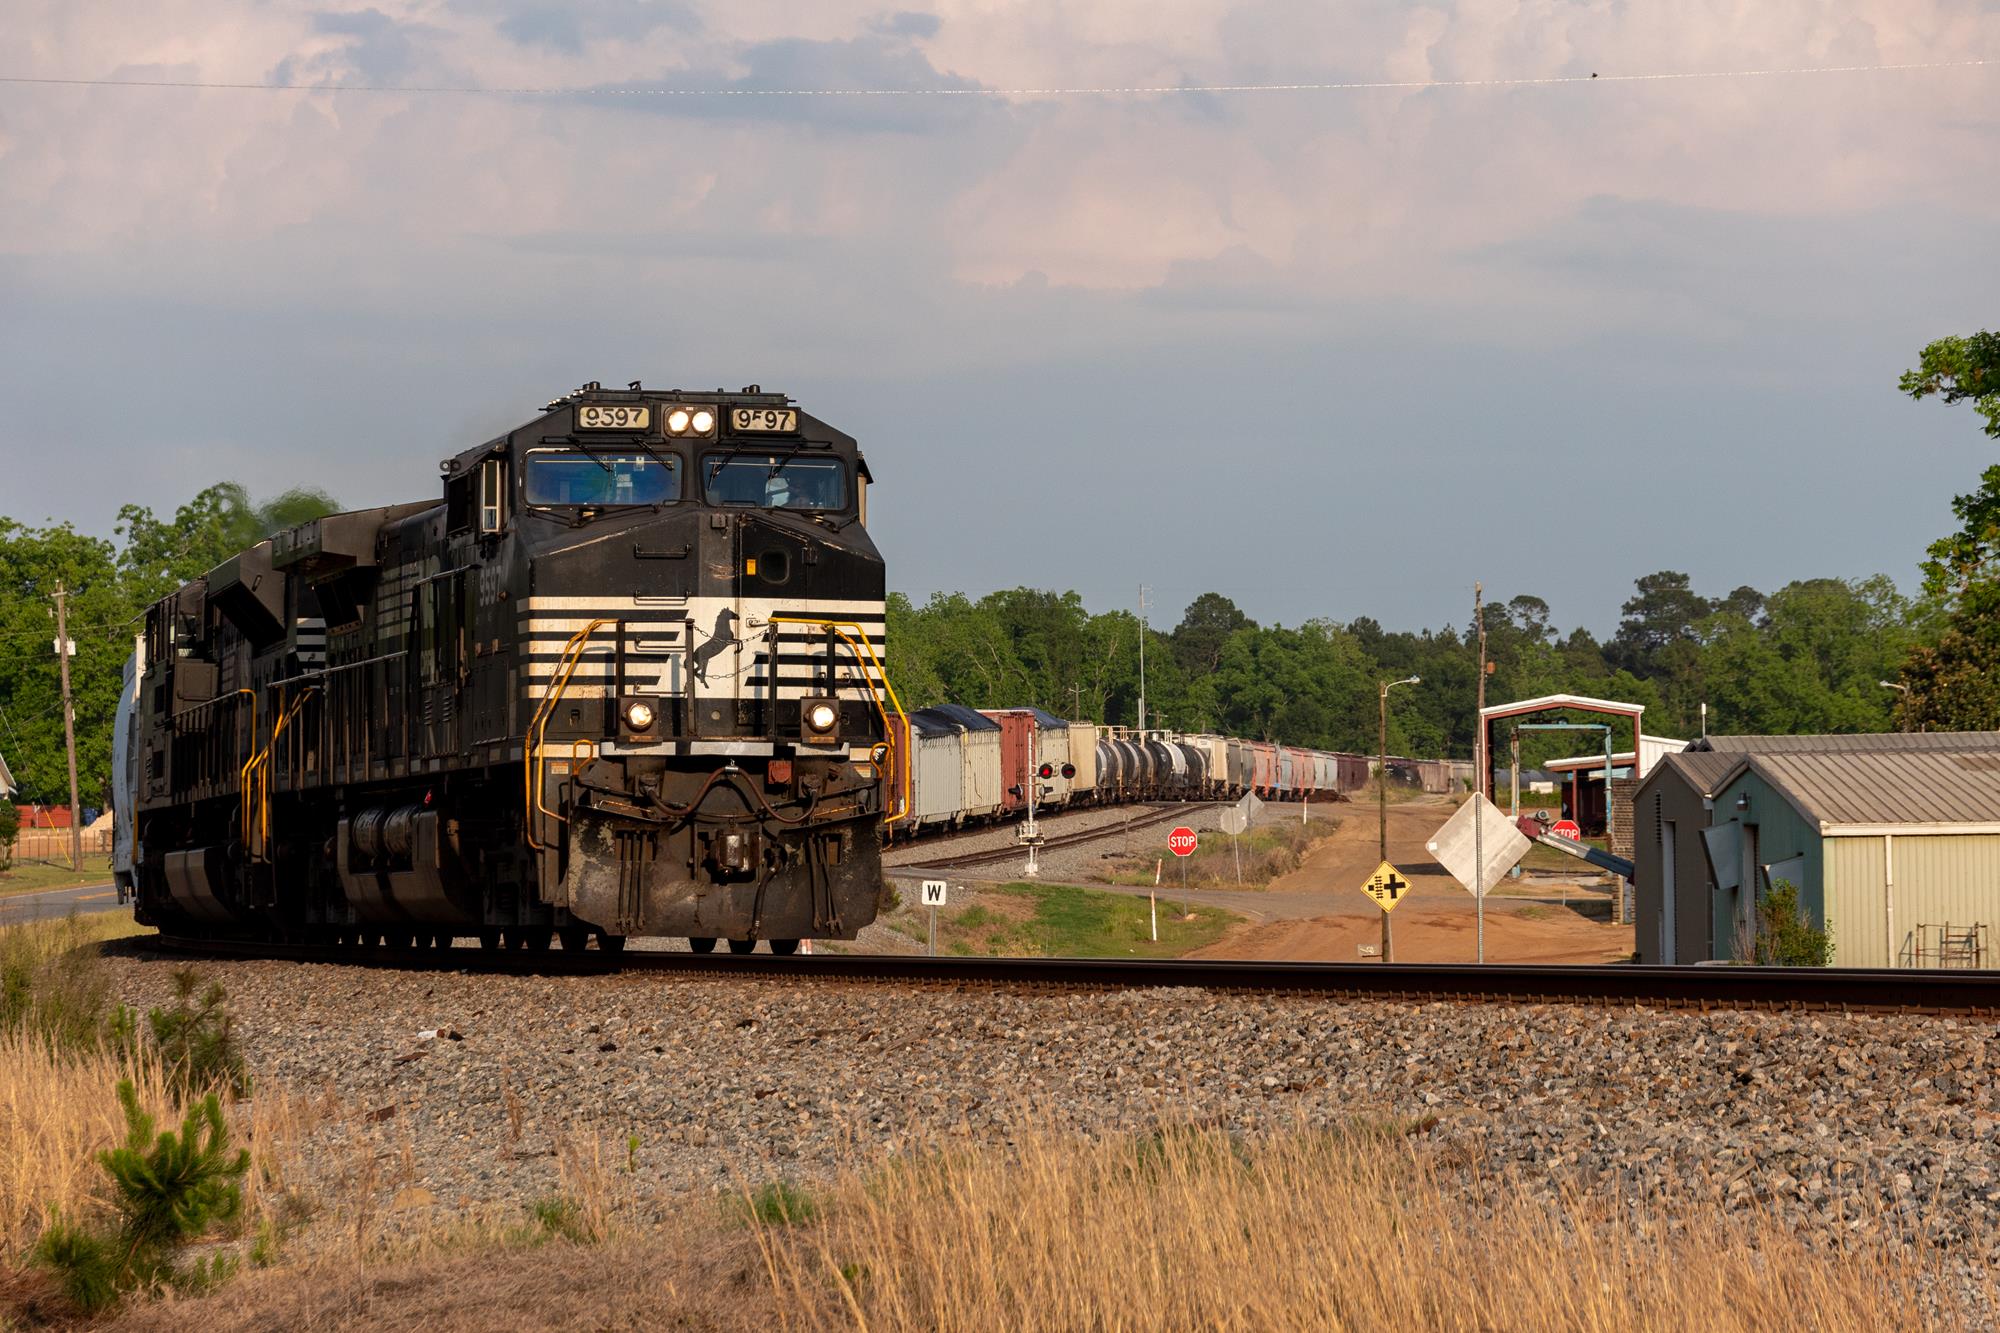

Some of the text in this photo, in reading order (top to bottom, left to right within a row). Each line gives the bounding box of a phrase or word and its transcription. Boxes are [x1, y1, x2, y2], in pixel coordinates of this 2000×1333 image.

[586, 407, 643, 427] 9597
[1170, 836, 1195, 847] STOP
[927, 884, 941, 901] W
